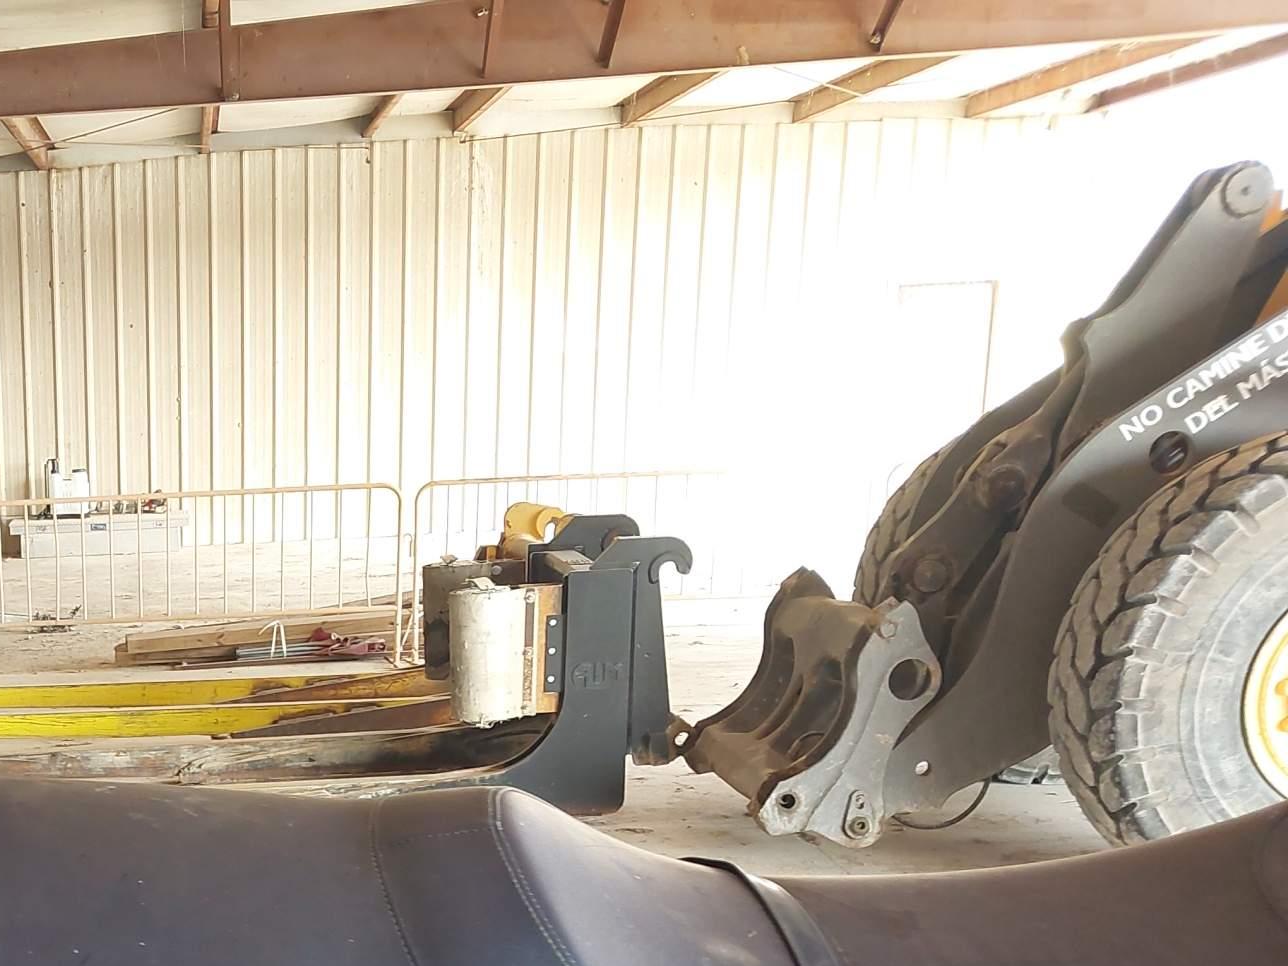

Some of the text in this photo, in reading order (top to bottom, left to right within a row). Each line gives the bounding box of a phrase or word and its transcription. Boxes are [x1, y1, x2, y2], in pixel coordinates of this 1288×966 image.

[1119, 405, 1163, 441] NO
[1166, 332, 1270, 409] CAMINE
[1184, 394, 1240, 434] DEL
